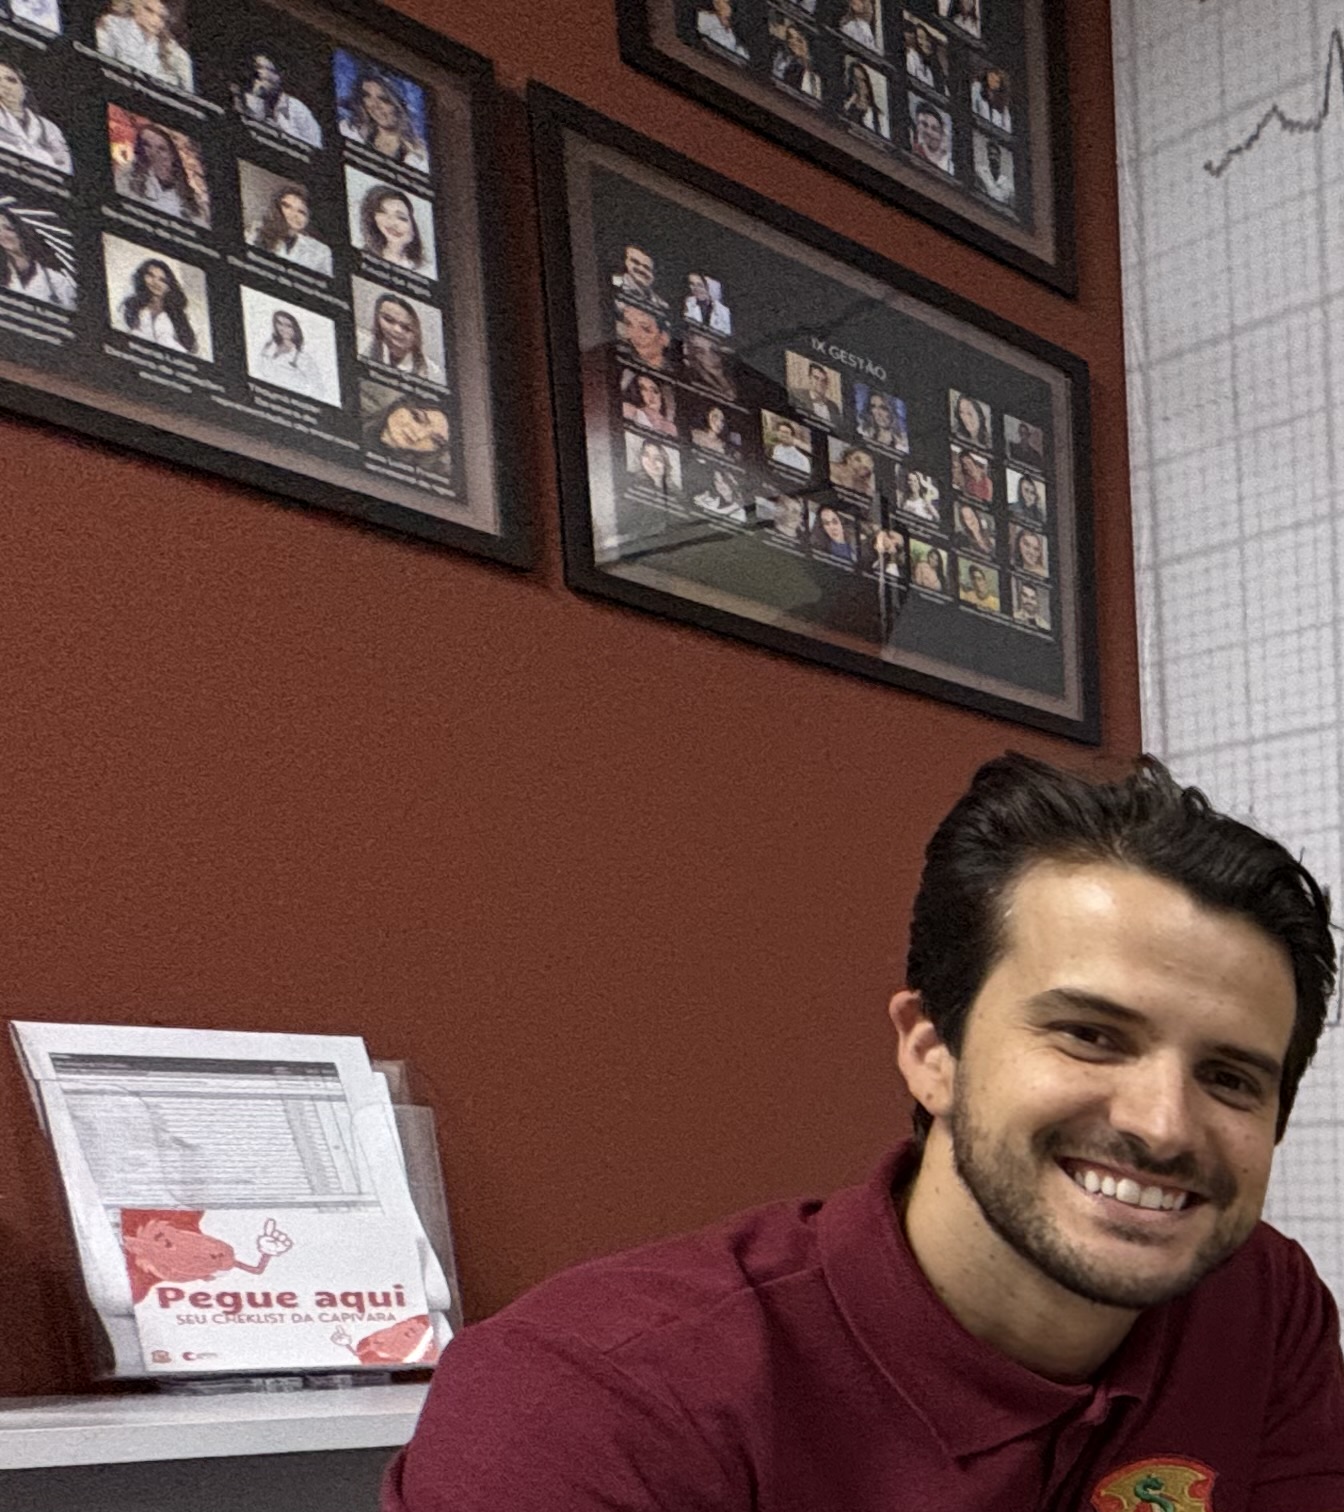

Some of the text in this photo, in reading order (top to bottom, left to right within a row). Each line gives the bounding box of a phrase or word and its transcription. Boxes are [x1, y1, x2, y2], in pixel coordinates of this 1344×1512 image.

[157, 1284, 407, 1315] Pegue aqui
[176, 1313, 208, 1326] SEU
[290, 1312, 315, 1324] DA
[317, 1311, 397, 1324] CAPIVARA
